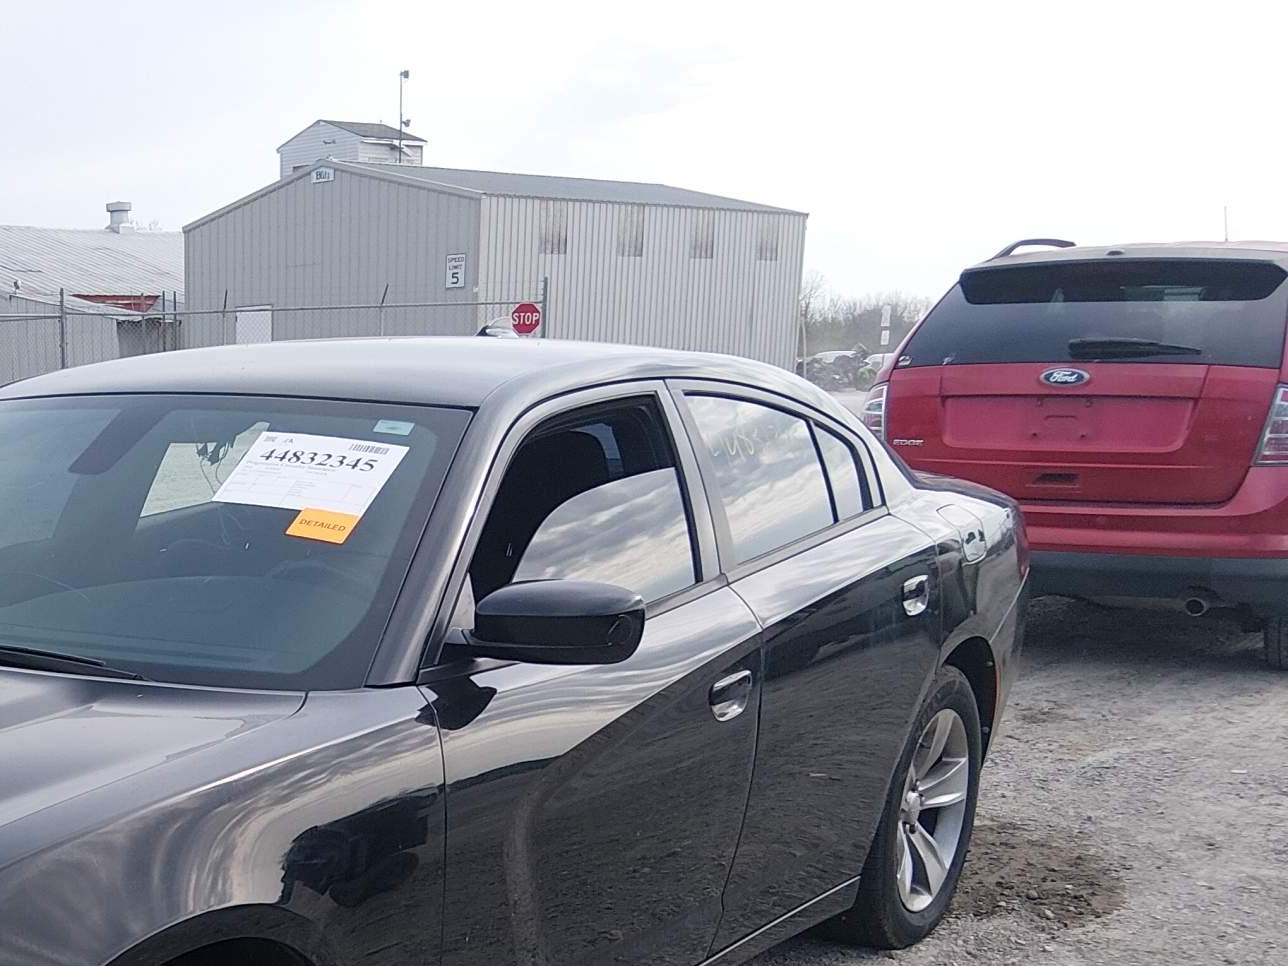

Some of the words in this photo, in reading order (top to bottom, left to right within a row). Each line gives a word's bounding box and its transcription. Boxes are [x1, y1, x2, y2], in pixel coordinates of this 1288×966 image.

[451, 272, 460, 284] 5
[512, 312, 540, 325] STOP
[1049, 370, 1079, 383] Ford
[260, 448, 379, 473] 44832345
[298, 518, 347, 533] DETAILED
